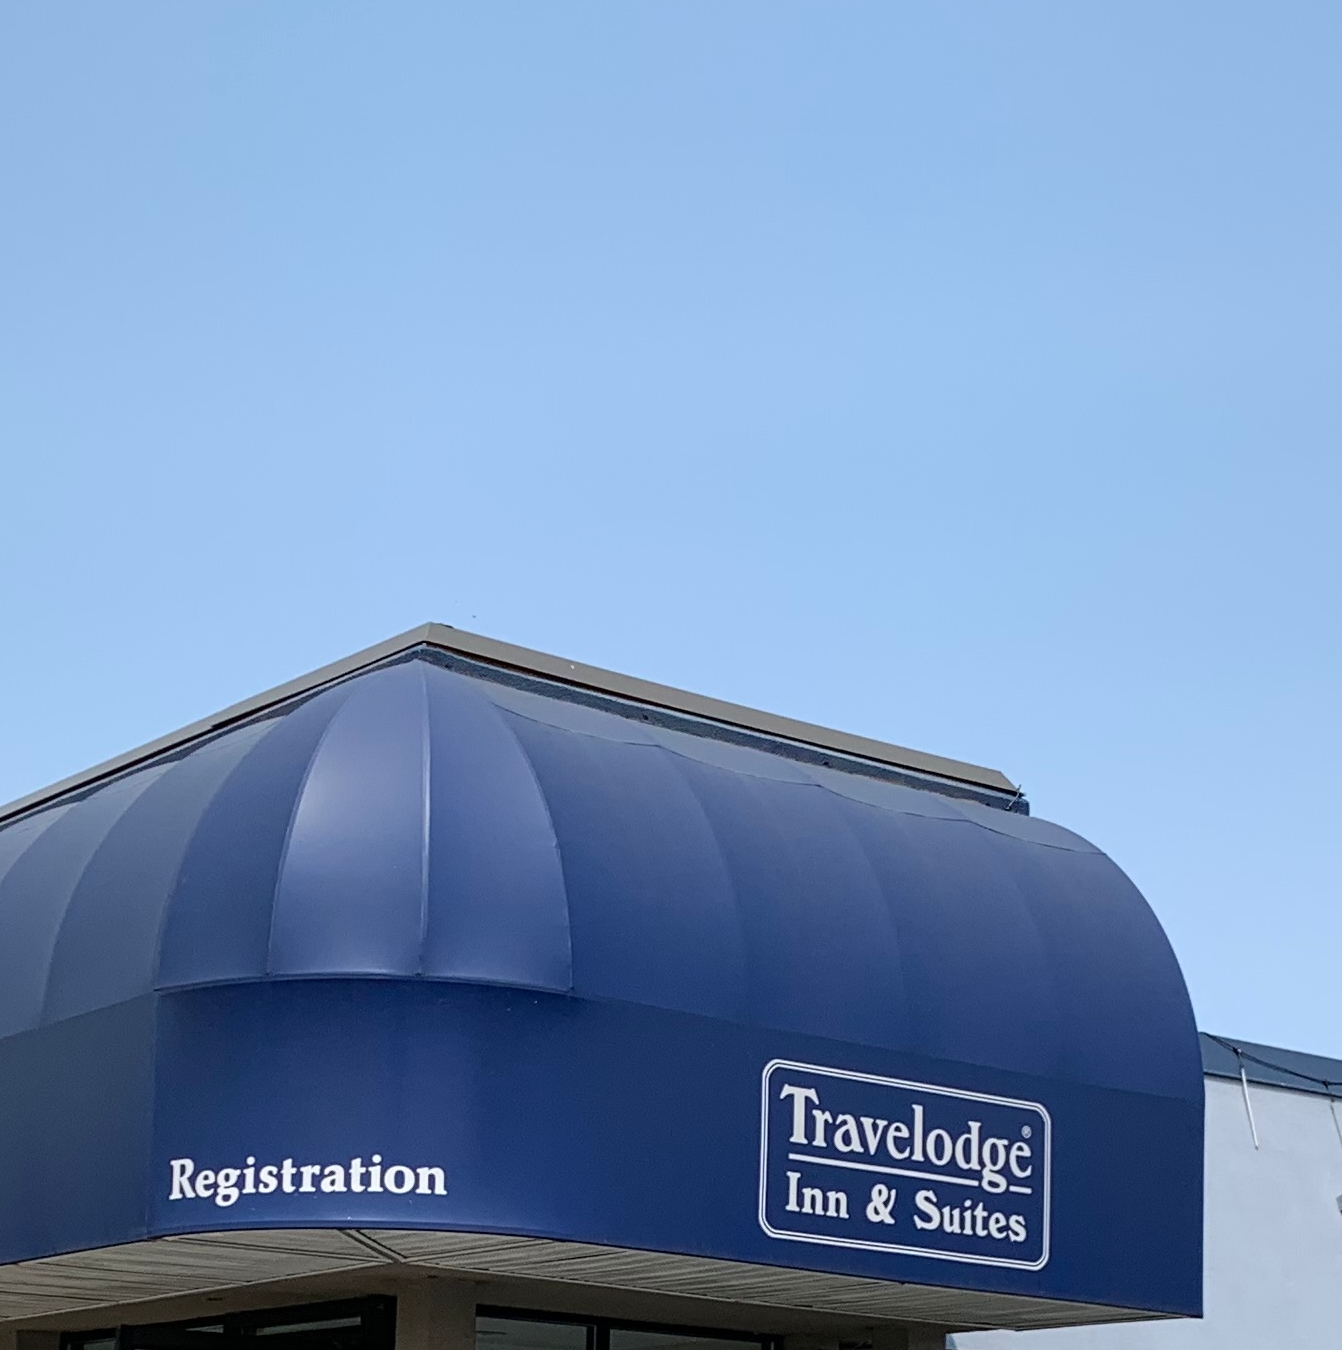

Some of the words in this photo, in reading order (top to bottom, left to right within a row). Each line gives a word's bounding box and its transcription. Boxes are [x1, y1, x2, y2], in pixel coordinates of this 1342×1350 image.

[780, 1084, 1032, 1193] Travelodge
[169, 1154, 447, 1207] Registration
[785, 1171, 849, 1218] Inn
[866, 1184, 896, 1224] &
[913, 1190, 1027, 1242] Suites
